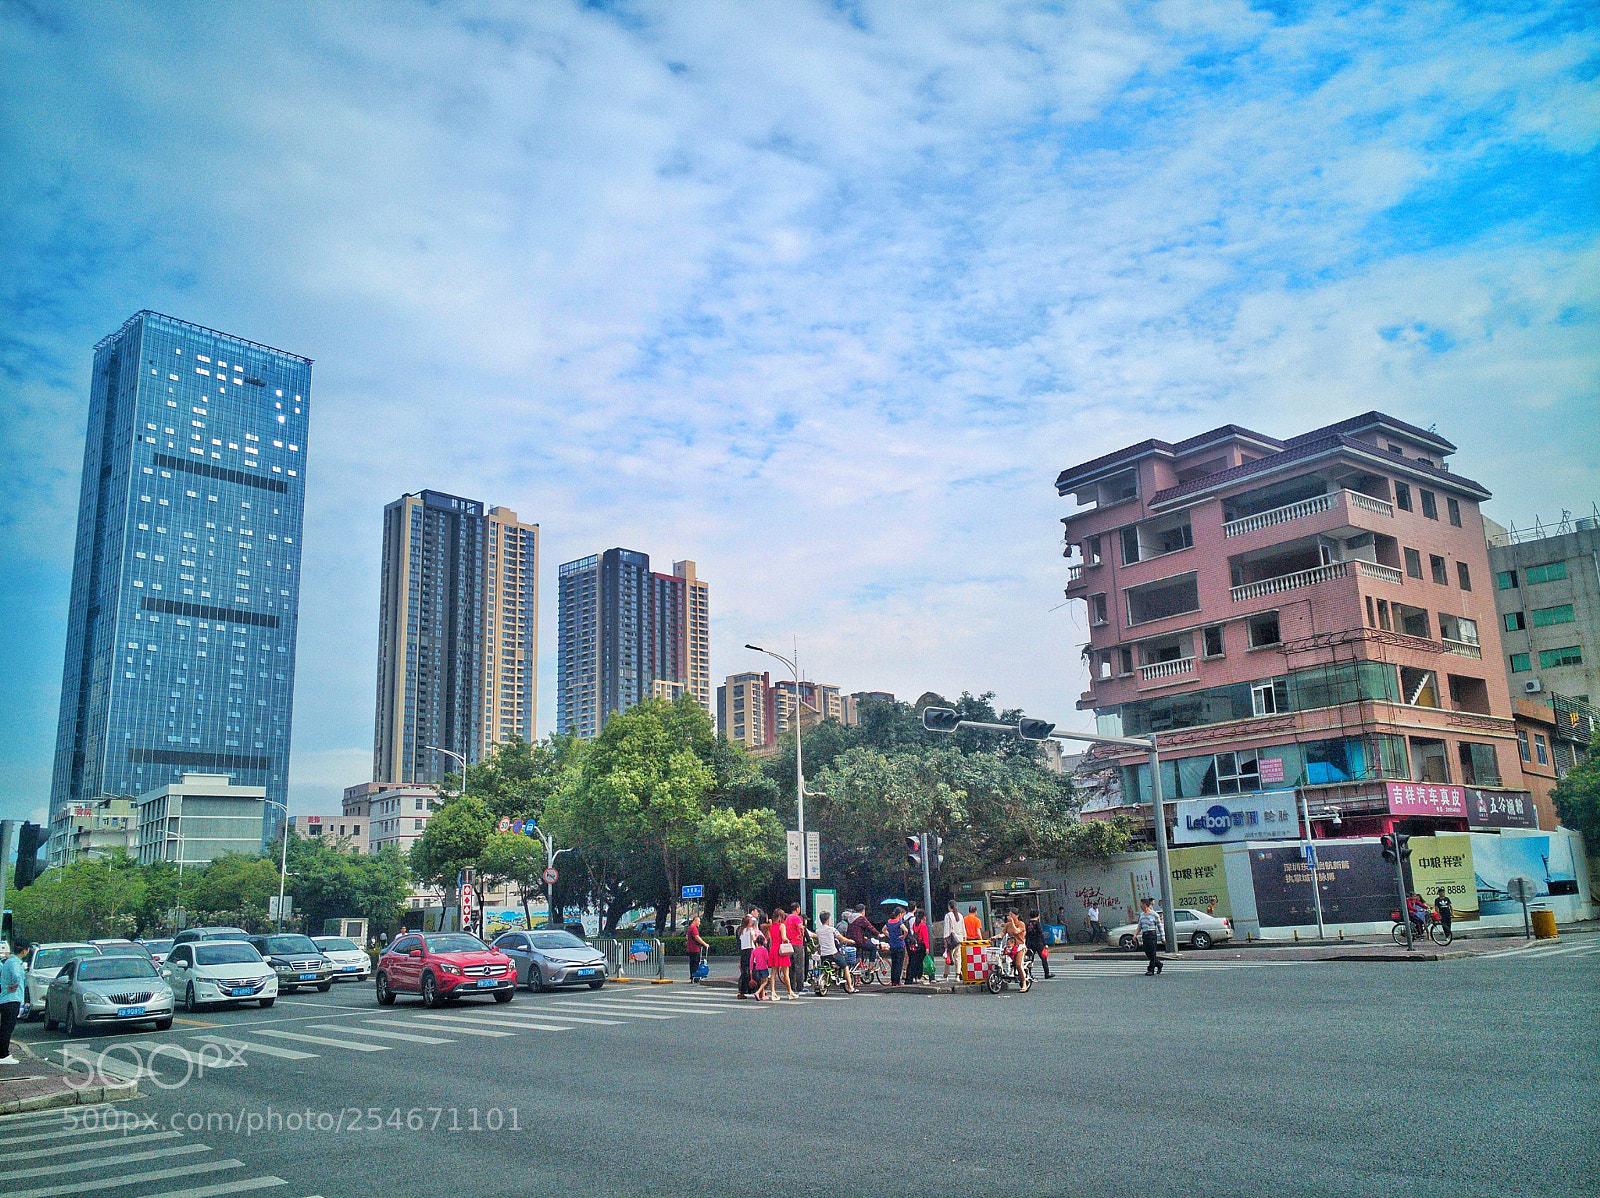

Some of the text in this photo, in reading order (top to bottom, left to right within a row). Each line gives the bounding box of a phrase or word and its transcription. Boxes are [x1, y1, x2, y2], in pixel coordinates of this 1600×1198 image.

[1393, 785, 1462, 806] 吉祥汽车真皮
[1283, 860, 1350, 872] 深圳东启航新篇
[1447, 885, 1466, 894] 8888
[1179, 896, 1198, 906] 2322
